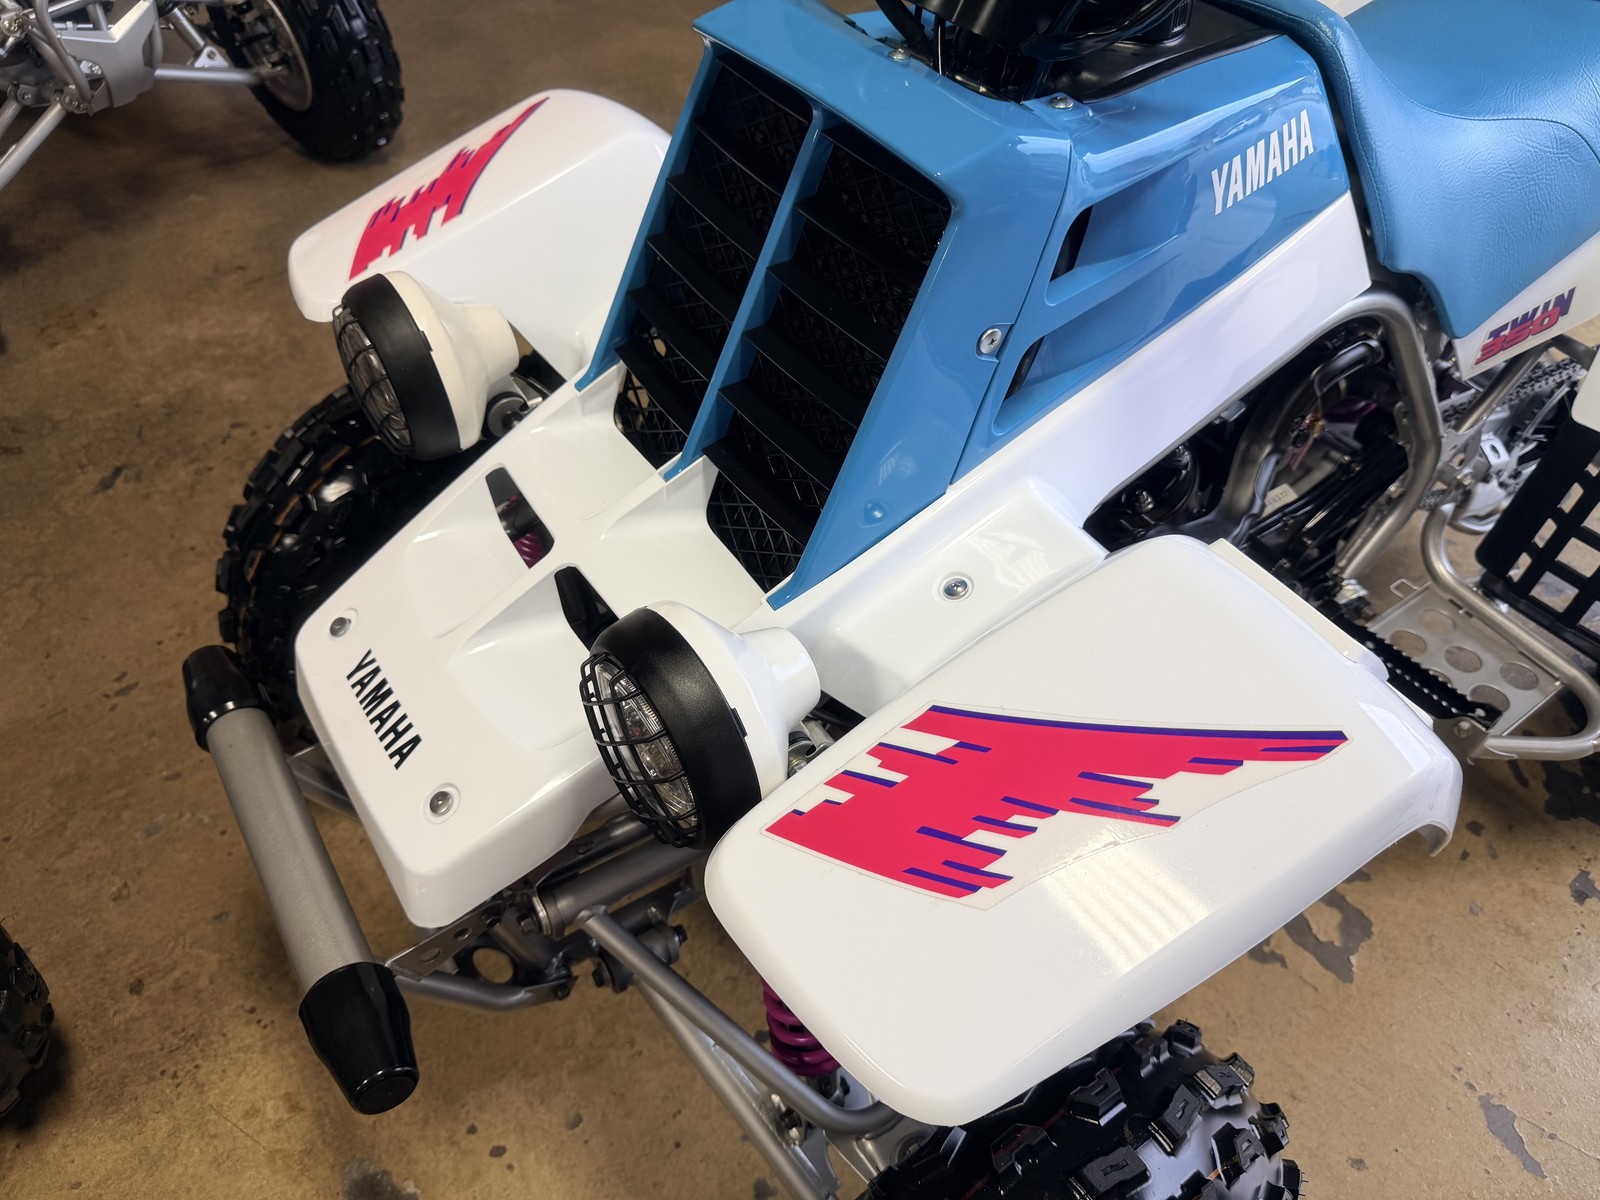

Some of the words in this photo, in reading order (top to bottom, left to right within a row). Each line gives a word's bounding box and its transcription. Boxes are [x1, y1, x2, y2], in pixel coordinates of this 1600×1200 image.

[1211, 108, 1314, 216] YAMAHA
[1475, 306, 1560, 365] 350
[1487, 286, 1576, 341] TWIN
[346, 648, 422, 770] YAMAHA
